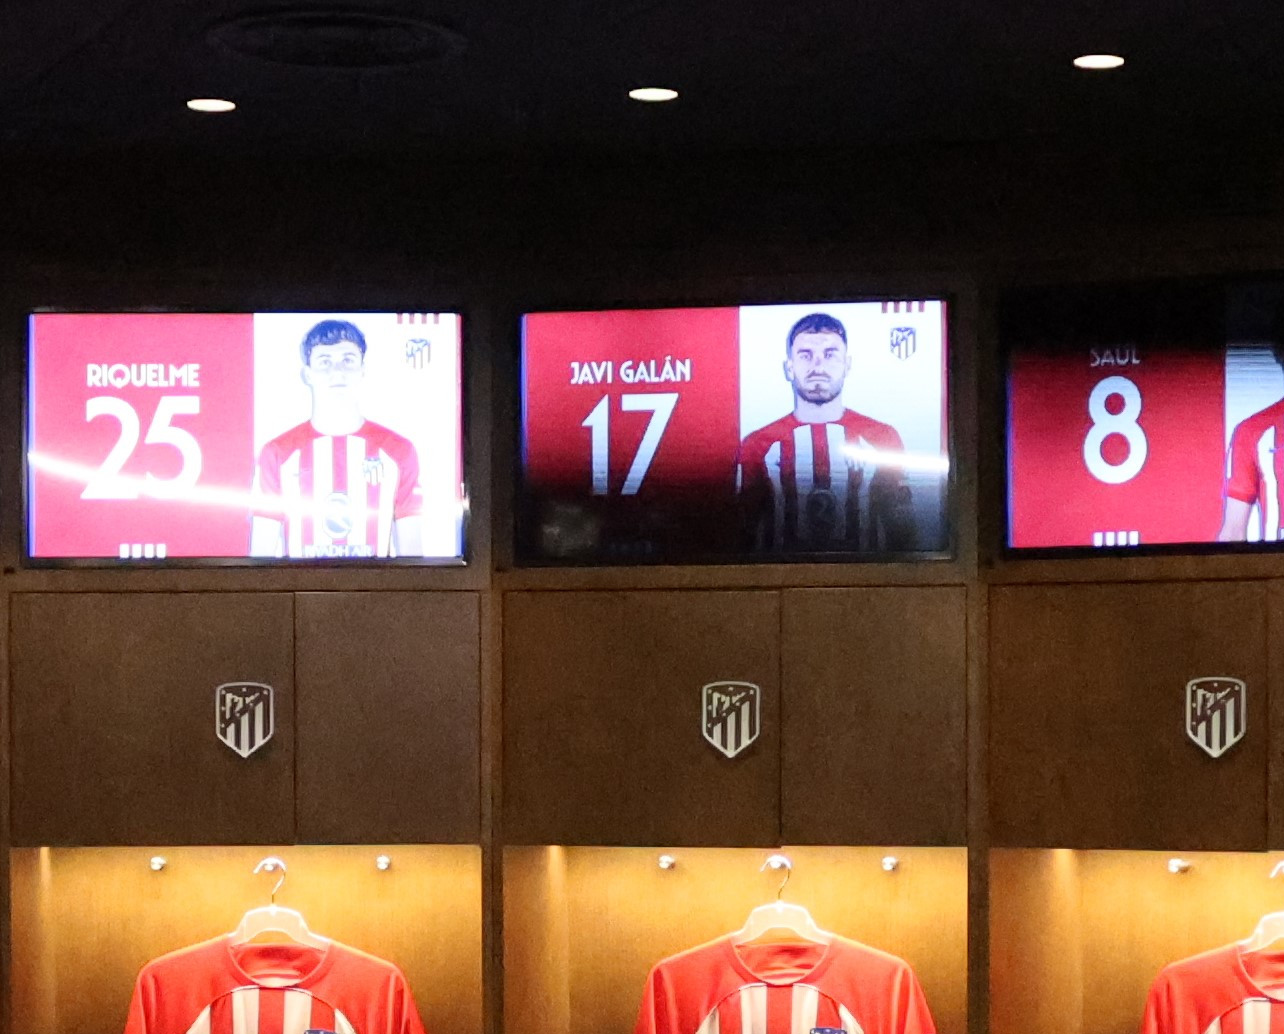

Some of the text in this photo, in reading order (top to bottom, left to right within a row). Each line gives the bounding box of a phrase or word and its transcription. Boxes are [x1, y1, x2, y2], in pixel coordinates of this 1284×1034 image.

[86, 363, 201, 389] RIQUELME
[570, 355, 692, 385] JAVI GALÁN
[80, 395, 203, 500] 25
[581, 392, 679, 495] 17
[1083, 375, 1148, 484] 8
